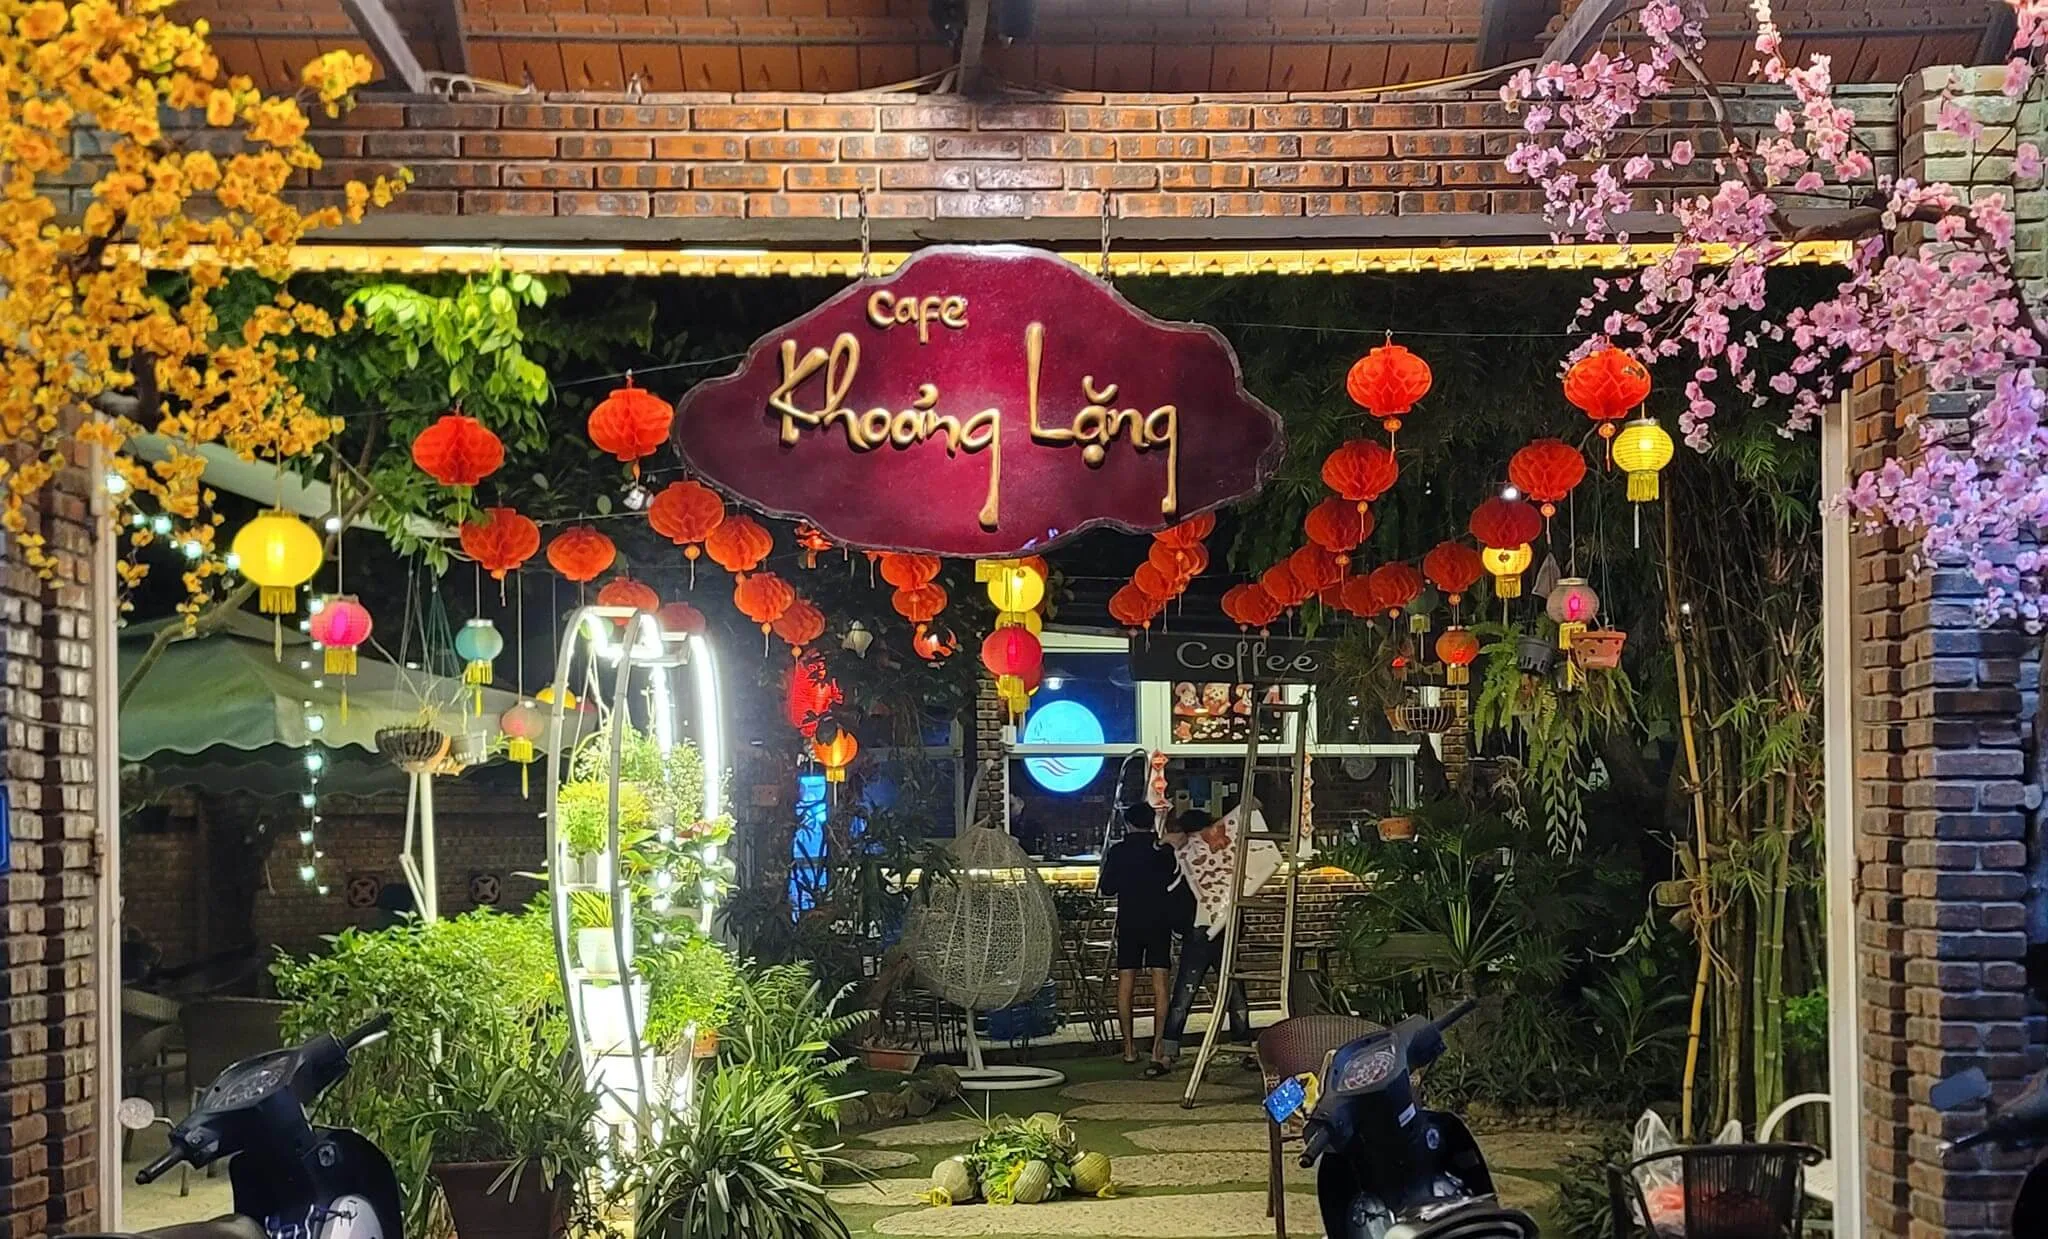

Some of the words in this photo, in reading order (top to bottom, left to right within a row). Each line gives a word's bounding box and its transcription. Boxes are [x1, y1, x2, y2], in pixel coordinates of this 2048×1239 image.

[769, 332, 1001, 528] Khoảng
[1026, 322, 1177, 514] Lặng
[1176, 641, 1320, 682] Coffee
